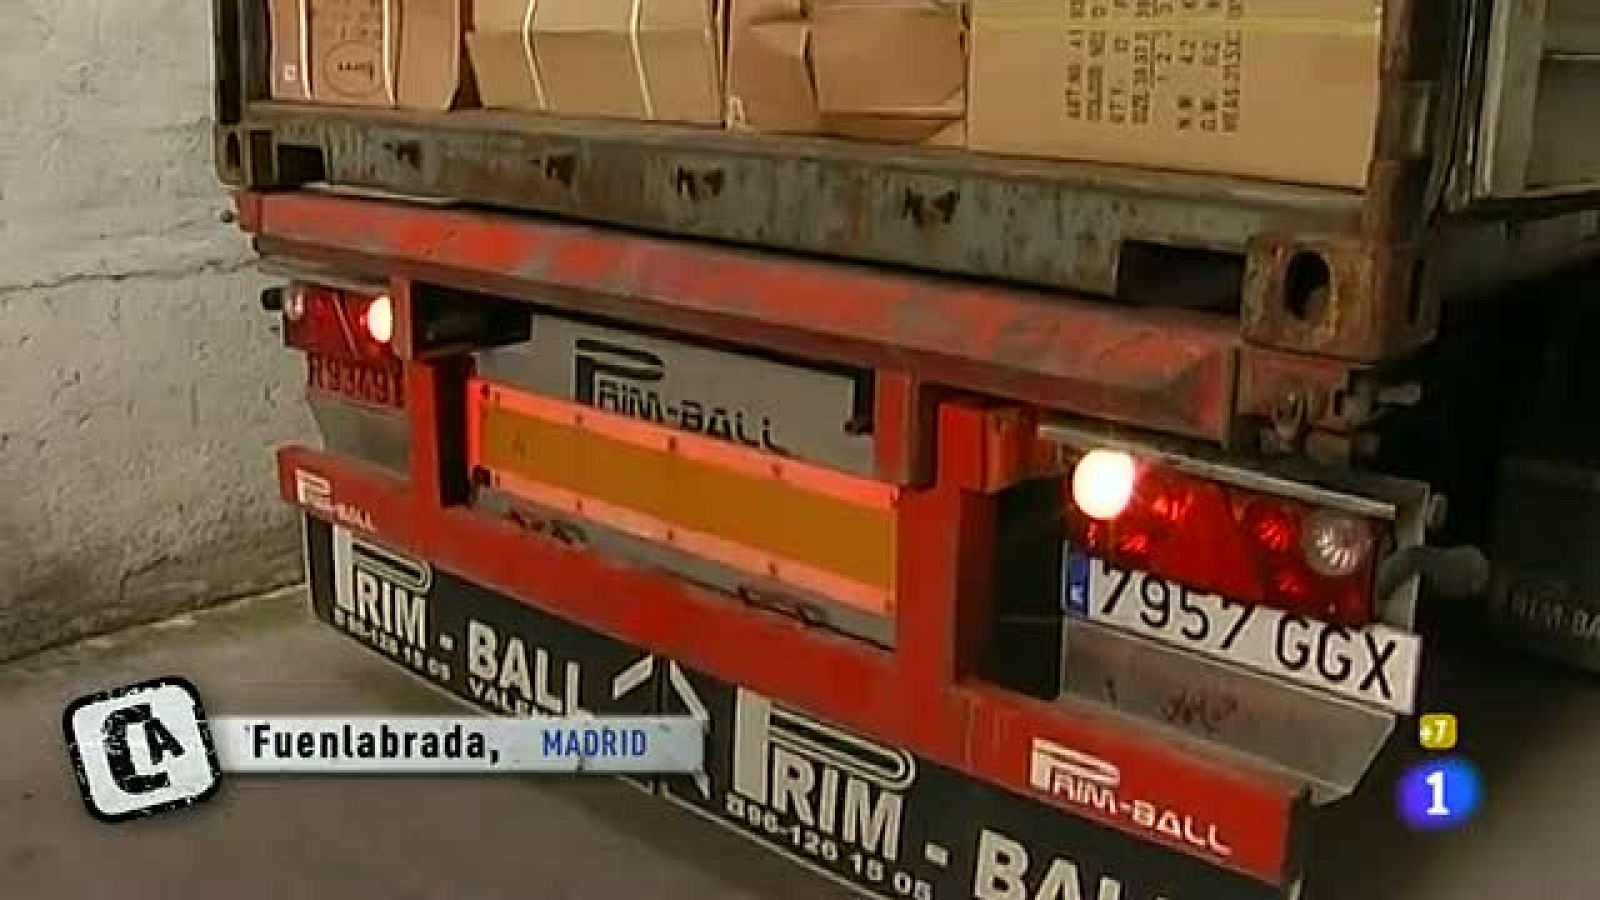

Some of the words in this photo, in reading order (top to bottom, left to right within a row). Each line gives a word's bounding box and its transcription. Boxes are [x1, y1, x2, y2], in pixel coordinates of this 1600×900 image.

[1101, 558, 1256, 650] 7957
[1275, 614, 1396, 700] GGX
[732, 687, 917, 862] PRIM
[1030, 737, 1232, 856] PRIM-BALL
